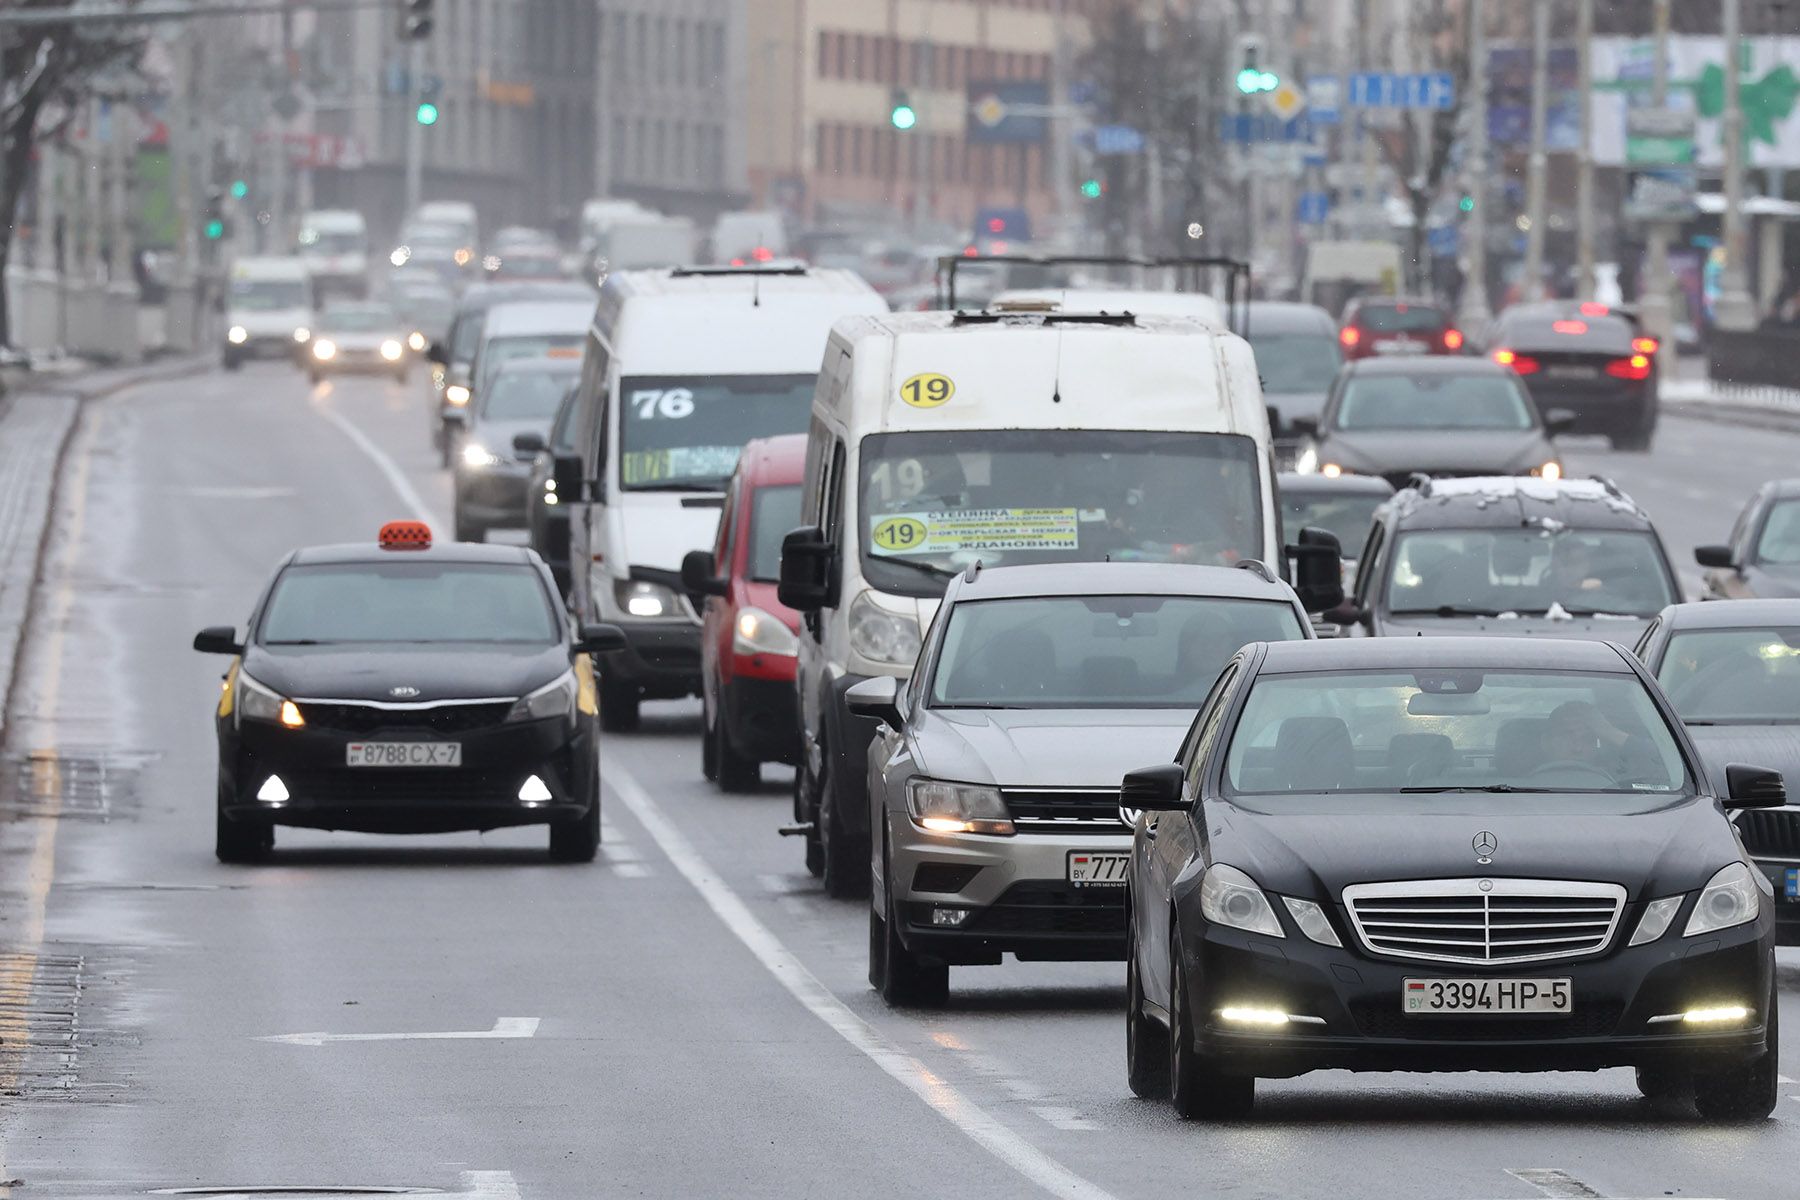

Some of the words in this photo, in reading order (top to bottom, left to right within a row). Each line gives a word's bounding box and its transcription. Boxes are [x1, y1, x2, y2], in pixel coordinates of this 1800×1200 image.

[905, 378, 950, 402] 19
[632, 387, 695, 420] 76
[871, 459, 925, 500] 19
[928, 509, 1009, 519] СТЕПЯНКА
[885, 523, 914, 544] 19
[959, 540, 1075, 550] ЖДАНОВИЧИ
[1073, 869, 1085, 879] BY
[1409, 998, 1424, 1009] BY
